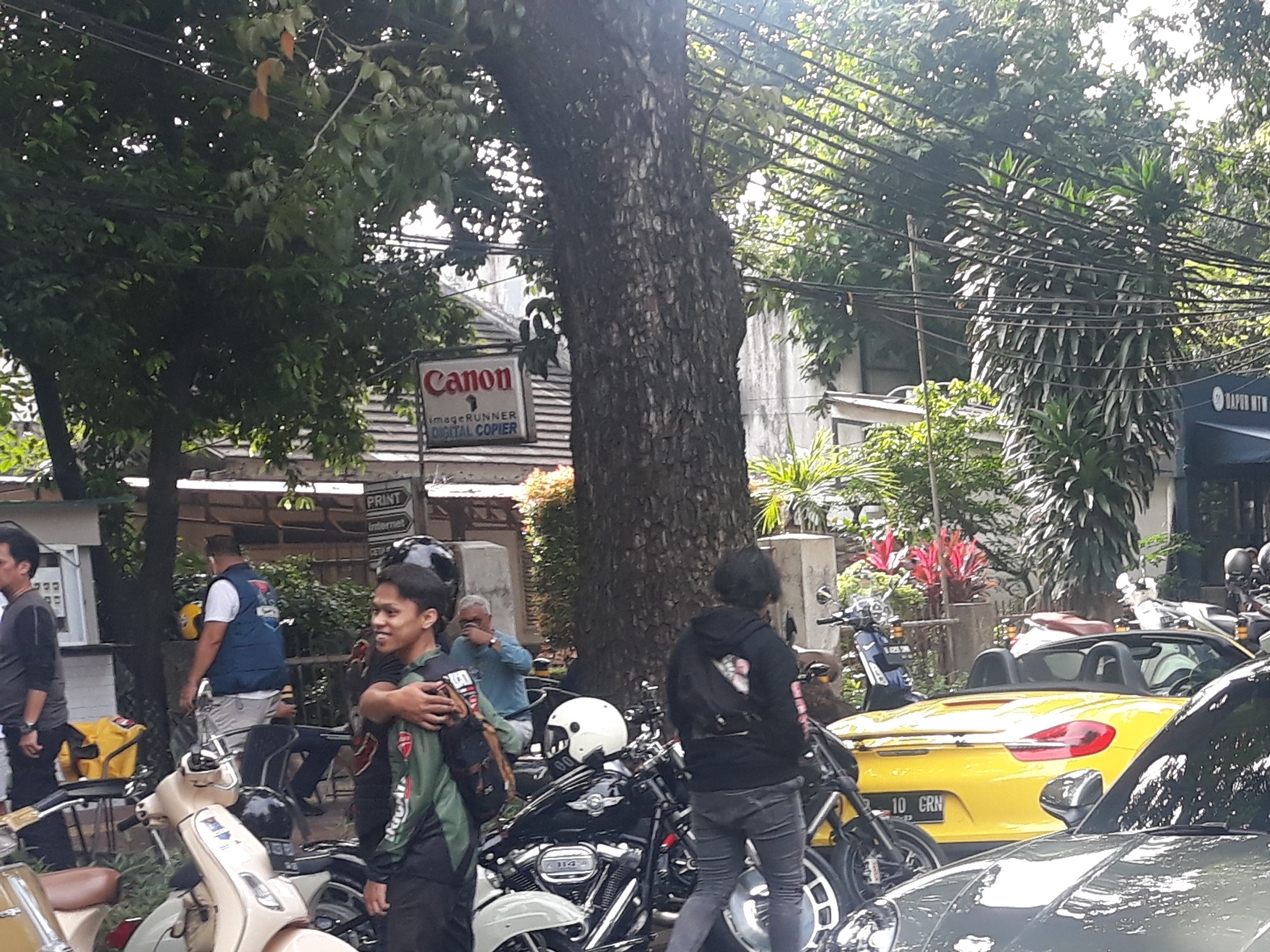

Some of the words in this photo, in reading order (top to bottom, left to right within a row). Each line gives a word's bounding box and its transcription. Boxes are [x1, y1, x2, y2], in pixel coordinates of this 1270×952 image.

[423, 367, 512, 396] Canon
[431, 425, 473, 440] DIGITAL
[475, 422, 518, 437] COPIER
[366, 491, 401, 509] PRINT
[891, 796, 907, 814] 10
